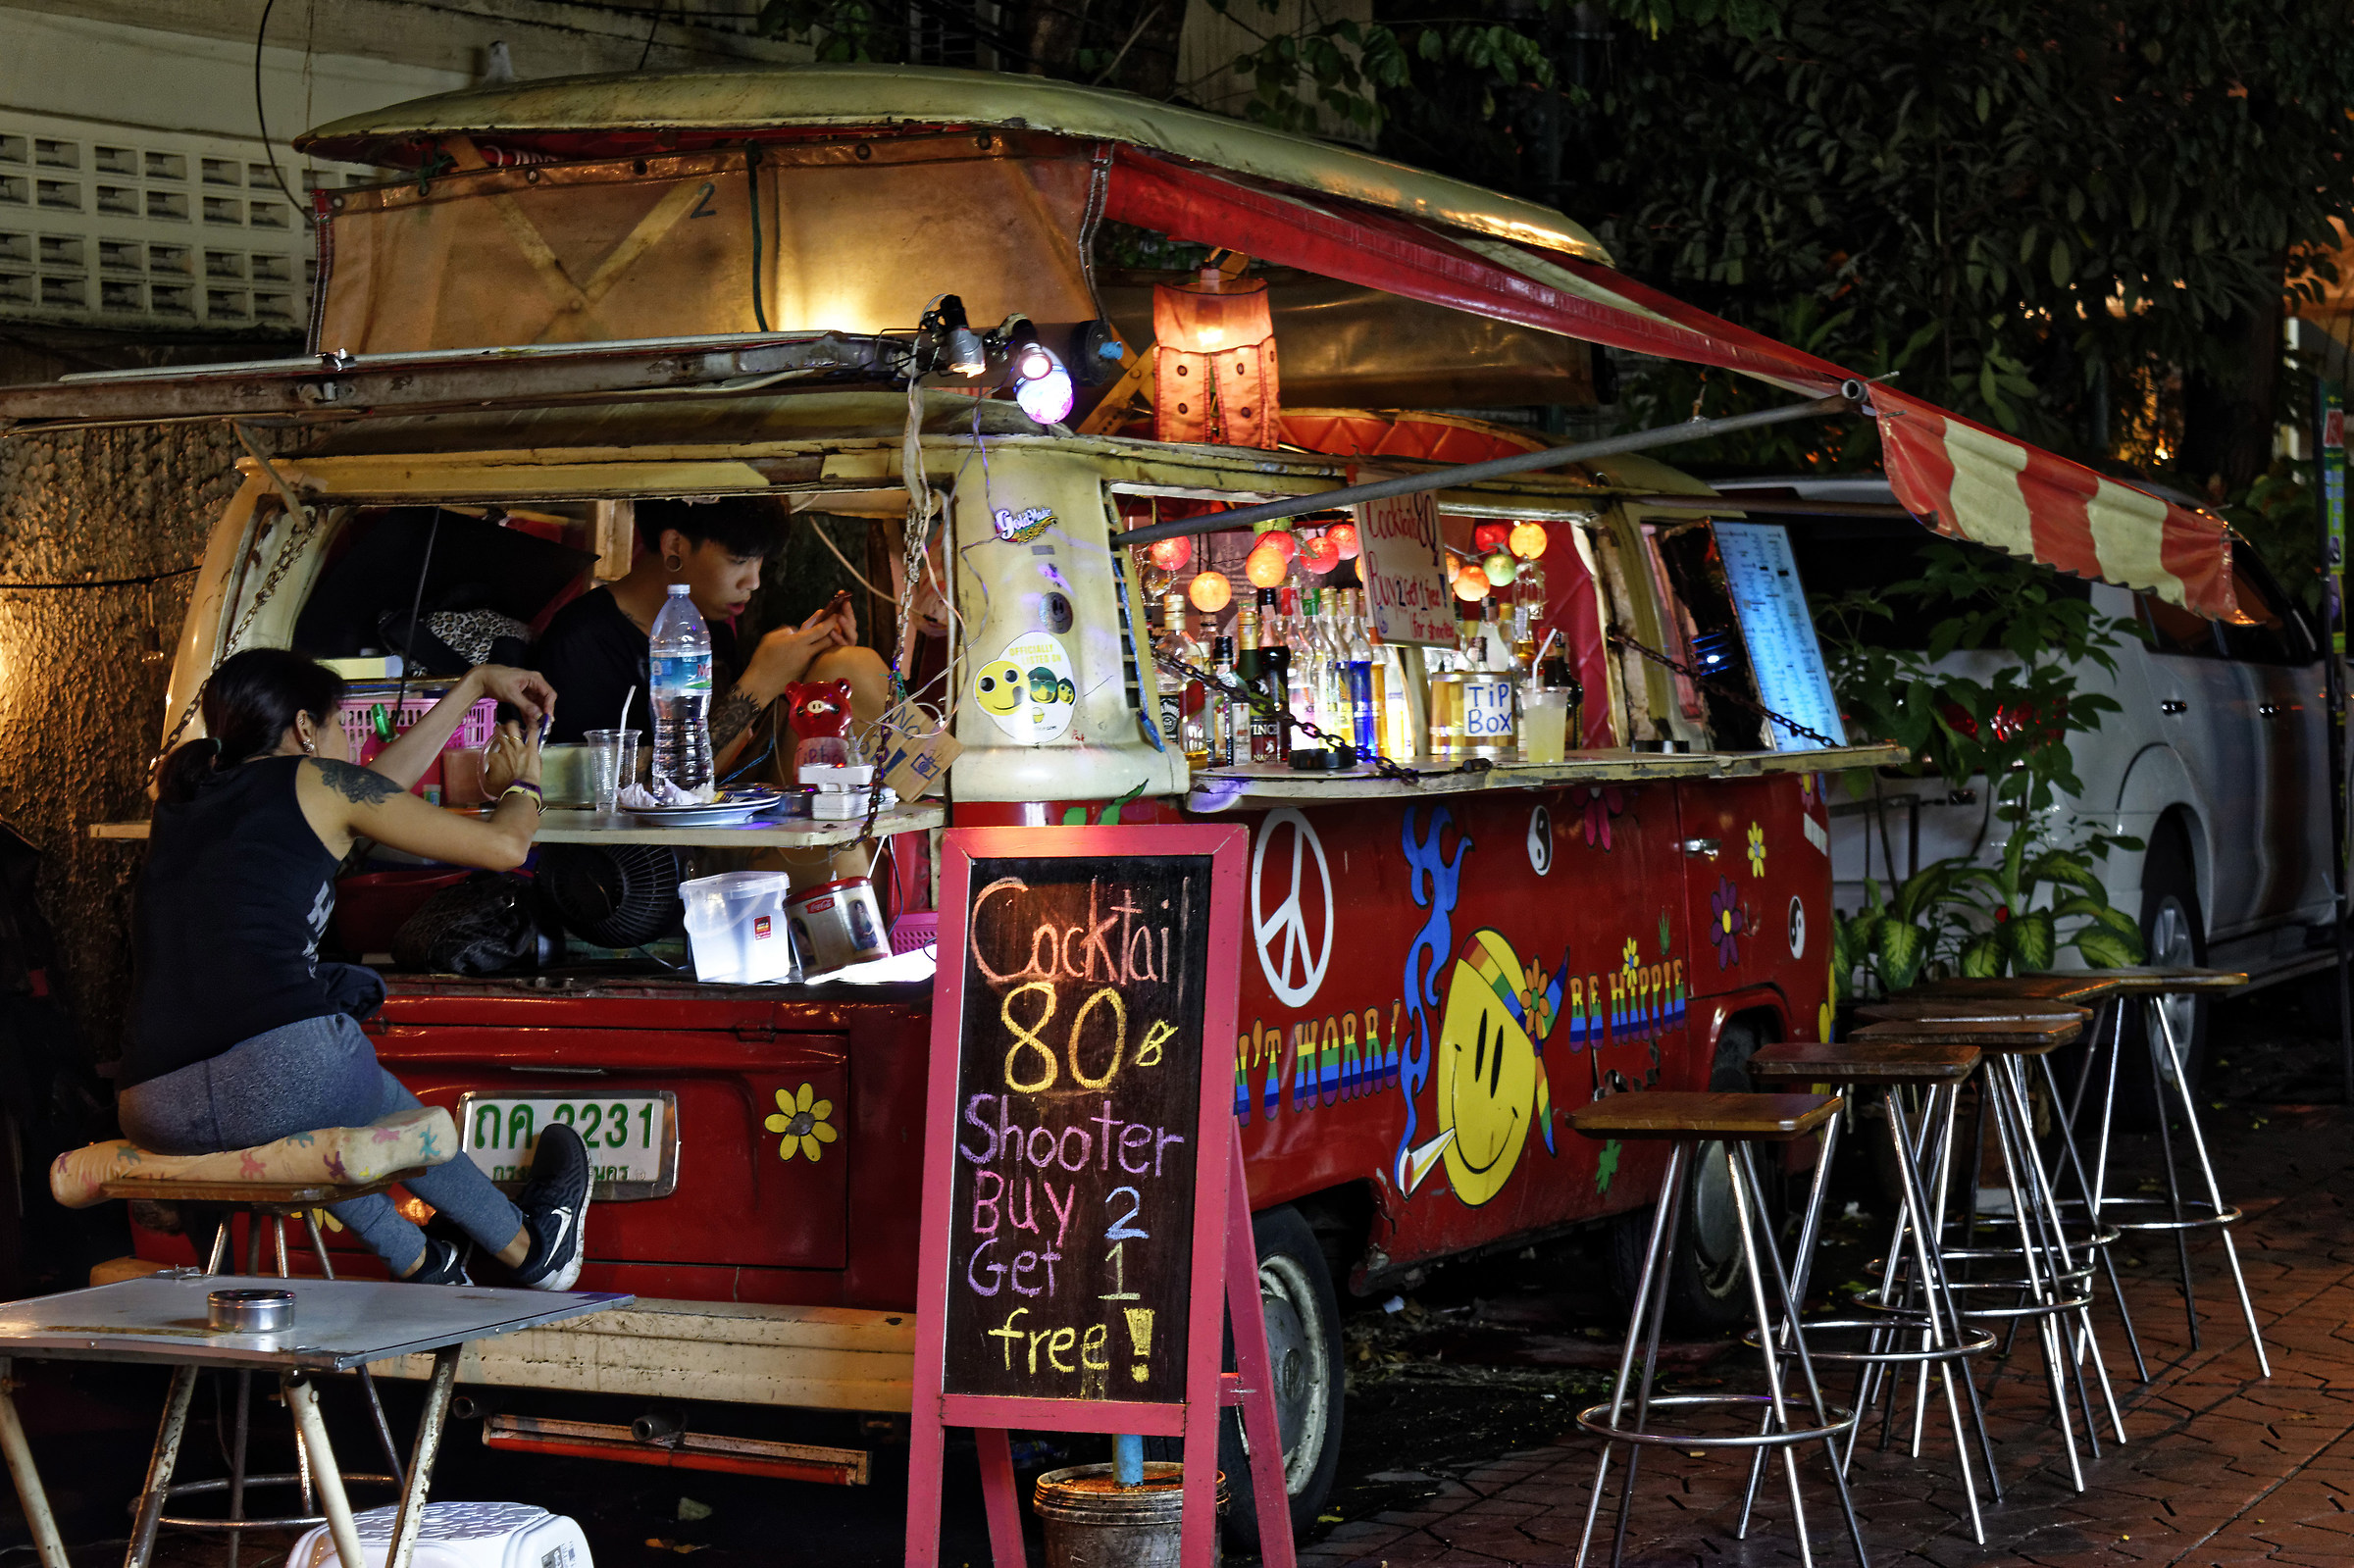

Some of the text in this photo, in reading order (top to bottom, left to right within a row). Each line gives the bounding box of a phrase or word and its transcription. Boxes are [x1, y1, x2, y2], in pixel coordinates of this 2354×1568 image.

[691, 181, 716, 219] 2
[1008, 643, 1053, 657] OFFICIALLY
[1051, 653, 1061, 663] ON
[970, 875, 1191, 1008] Cocktail
[1001, 981, 1127, 1093] 80
[1569, 972, 1605, 1054] BE
[959, 1092, 1185, 1177] Shooter
[1103, 1186, 1151, 1239] 2
[967, 1238, 1141, 1300] Get 1
